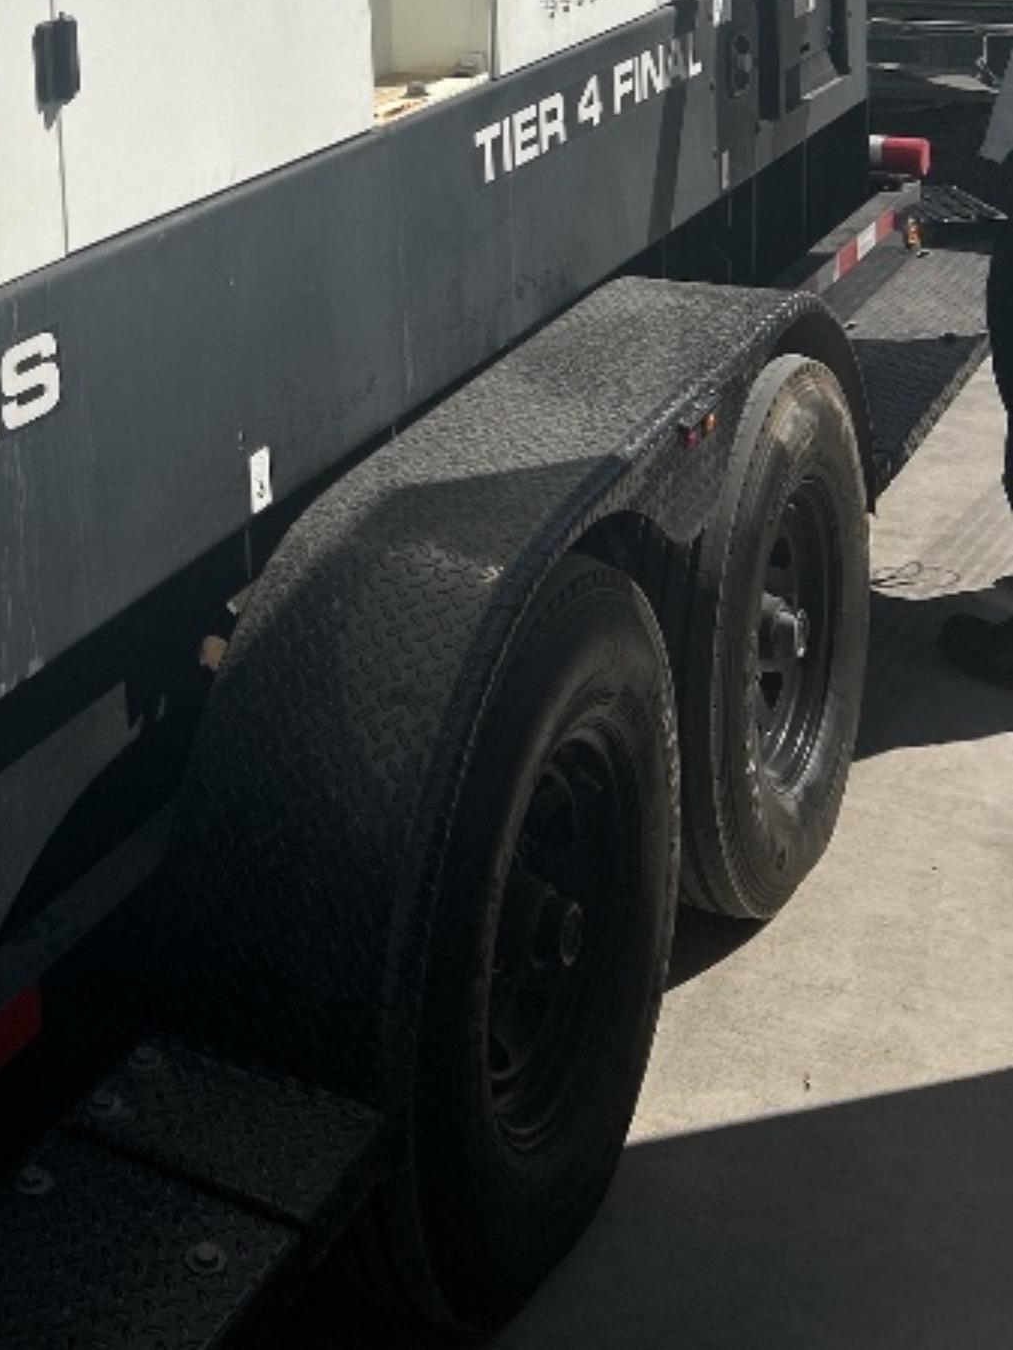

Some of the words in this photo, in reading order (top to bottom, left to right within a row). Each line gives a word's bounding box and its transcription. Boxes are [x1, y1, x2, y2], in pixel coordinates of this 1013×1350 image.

[474, 92, 568, 184] TIER
[577, 74, 604, 128] 4
[613, 34, 702, 115] FINAL
